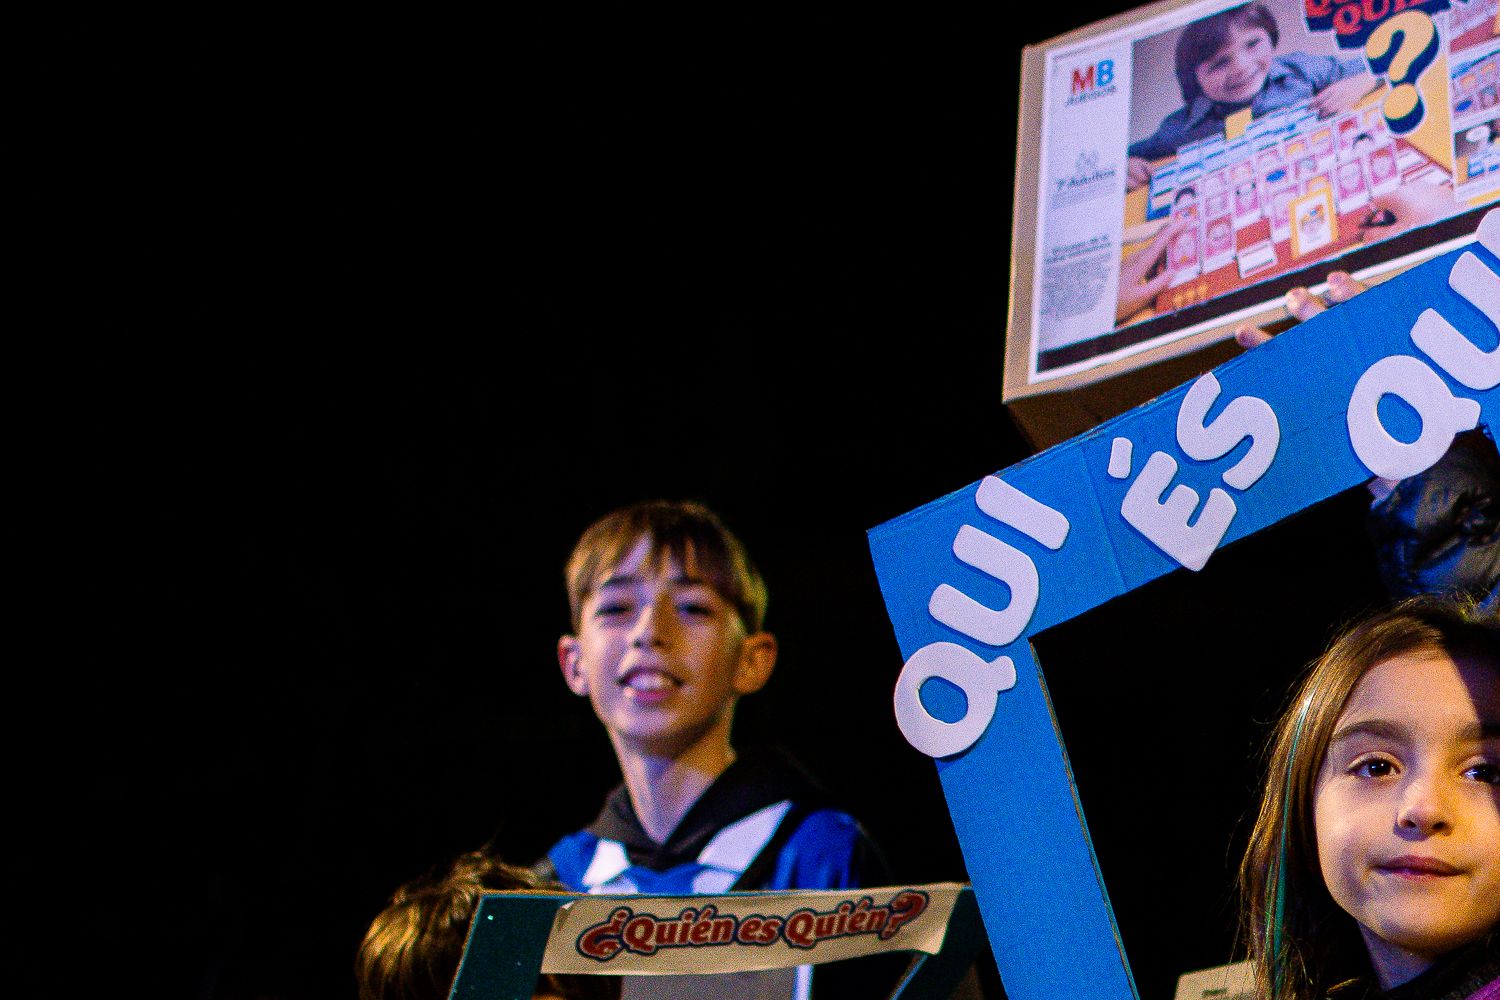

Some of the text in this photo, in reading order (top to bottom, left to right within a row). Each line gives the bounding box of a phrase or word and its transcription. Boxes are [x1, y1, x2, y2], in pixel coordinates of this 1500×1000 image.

[1071, 58, 1115, 96] MB
[893, 475, 1070, 758] QUI
[1107, 372, 1281, 573] ÉS
[576, 889, 930, 962] ¿Quién es Quién?
